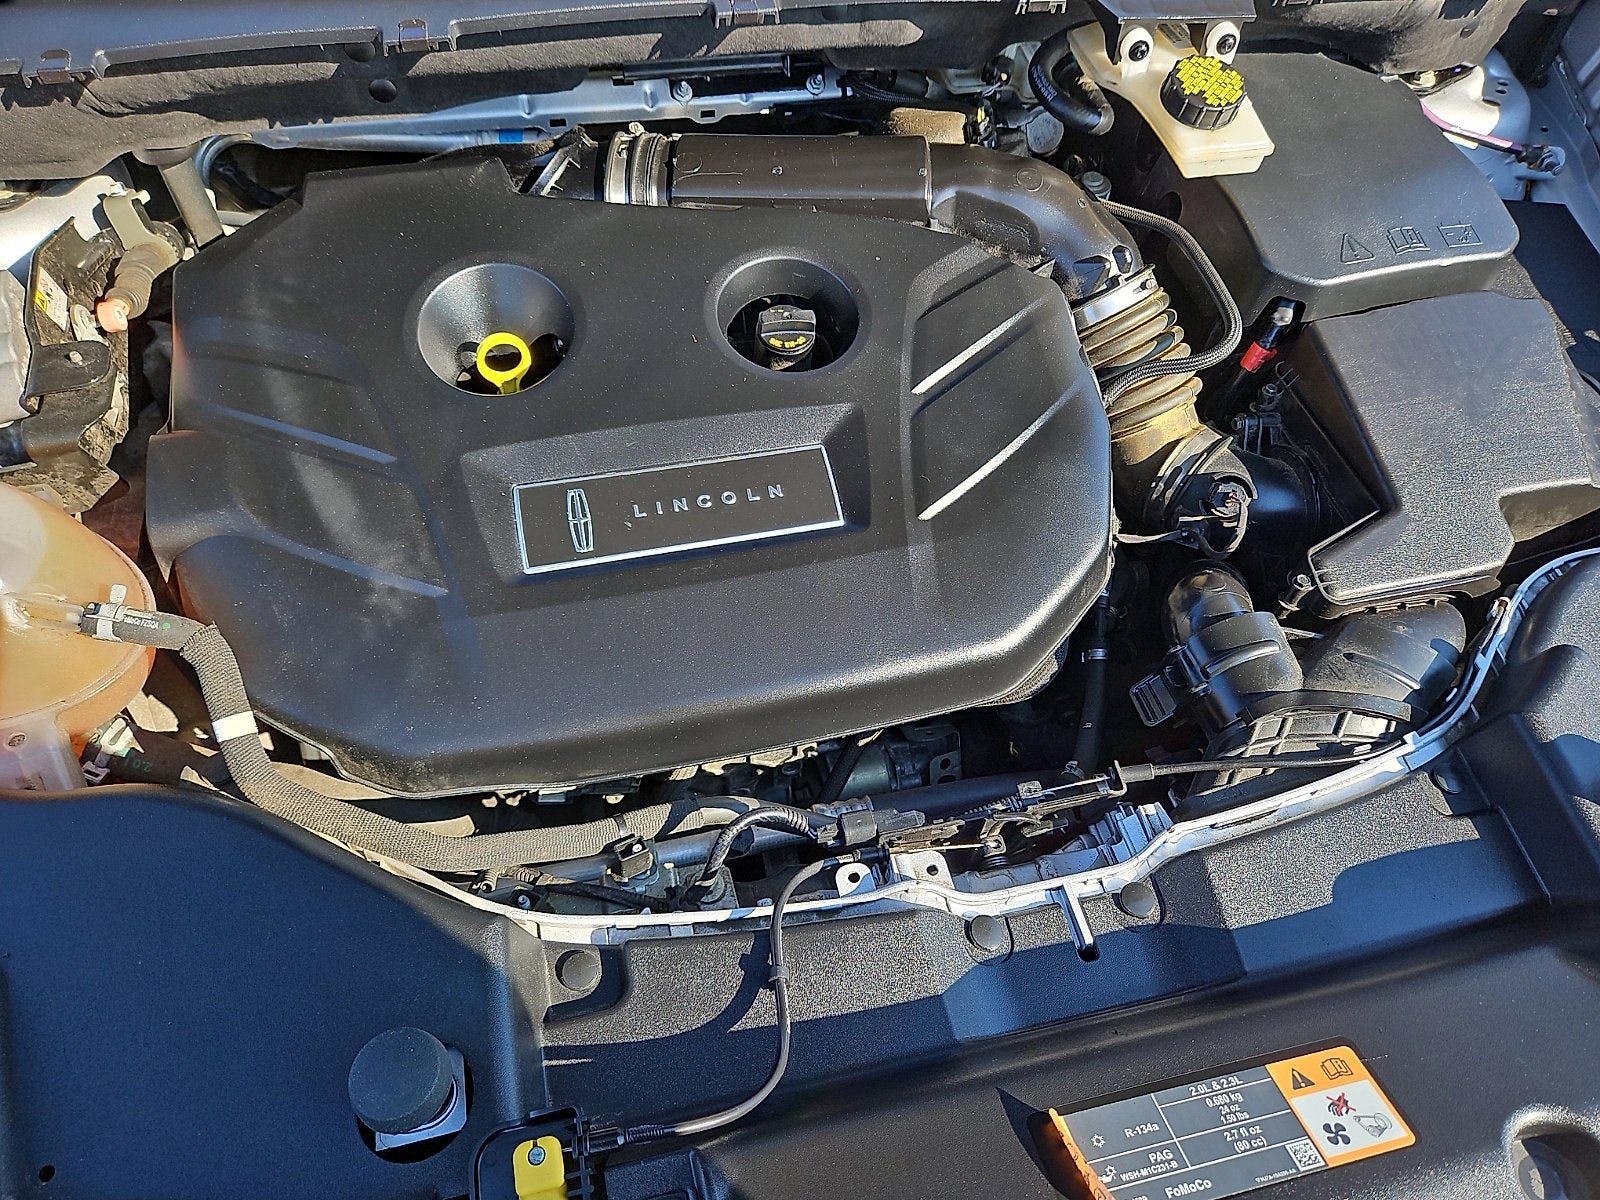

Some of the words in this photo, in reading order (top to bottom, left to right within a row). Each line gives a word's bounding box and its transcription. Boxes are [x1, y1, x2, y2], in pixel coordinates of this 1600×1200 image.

[632, 483, 785, 520] LINCOLN
[1188, 1084, 1212, 1097] 2.0L
[1212, 1081, 1221, 1091] &
[1220, 1075, 1244, 1088] 2.3L
[1205, 1093, 1230, 1108] 0.680
[1229, 1092, 1244, 1102] kg
[1219, 1105, 1230, 1115] 24
[1229, 1103, 1241, 1112] oz
[1220, 1113, 1237, 1125] 1.50
[1236, 1111, 1250, 1122] lbs
[1124, 1122, 1160, 1138] R-134a
[1223, 1128, 1239, 1142] 2.7
[1239, 1127, 1249, 1138] fl
[1248, 1125, 1263, 1135] oz
[1233, 1140, 1250, 1154] (80
[1251, 1135, 1268, 1148] cc)
[1148, 1149, 1174, 1164] PAG
[1119, 1160, 1179, 1182] WSH-M1C231-B
[1164, 1178, 1212, 1199] FoMoCo
